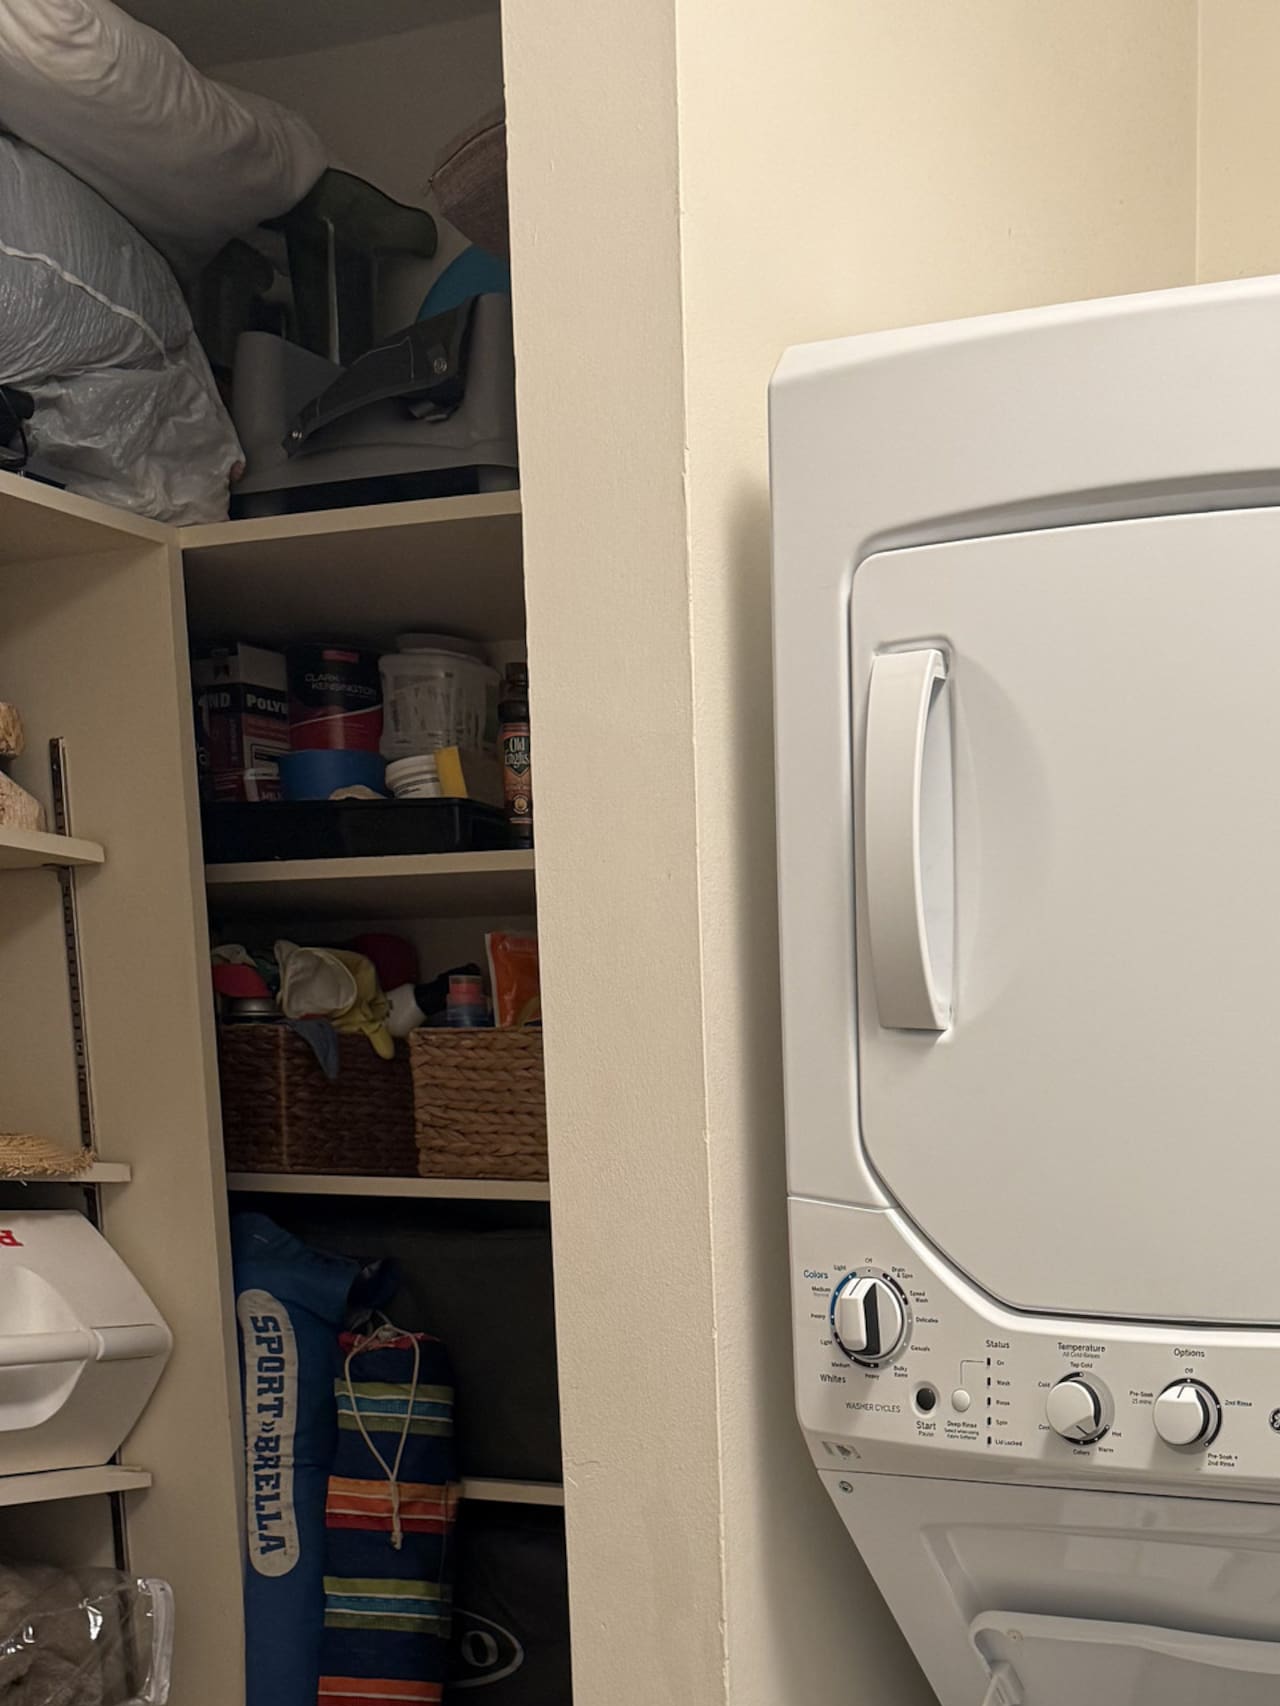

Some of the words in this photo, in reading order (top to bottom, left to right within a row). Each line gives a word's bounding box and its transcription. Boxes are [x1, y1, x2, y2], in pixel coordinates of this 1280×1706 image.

[509, 736, 525, 752] Old
[505, 752, 529, 769] Englis
[803, 1270, 829, 1279] Colors
[986, 1340, 1010, 1349] Status
[1058, 1342, 1106, 1353] Temperature
[1174, 1347, 1205, 1358] Options
[250, 1315, 285, 1420] SPORT
[820, 1374, 846, 1383] Whites
[845, 1402, 874, 1411] WASHER
[875, 1404, 901, 1413] CYCLES
[916, 1421, 937, 1431] Start
[253, 1434, 287, 1555] BRELLA
